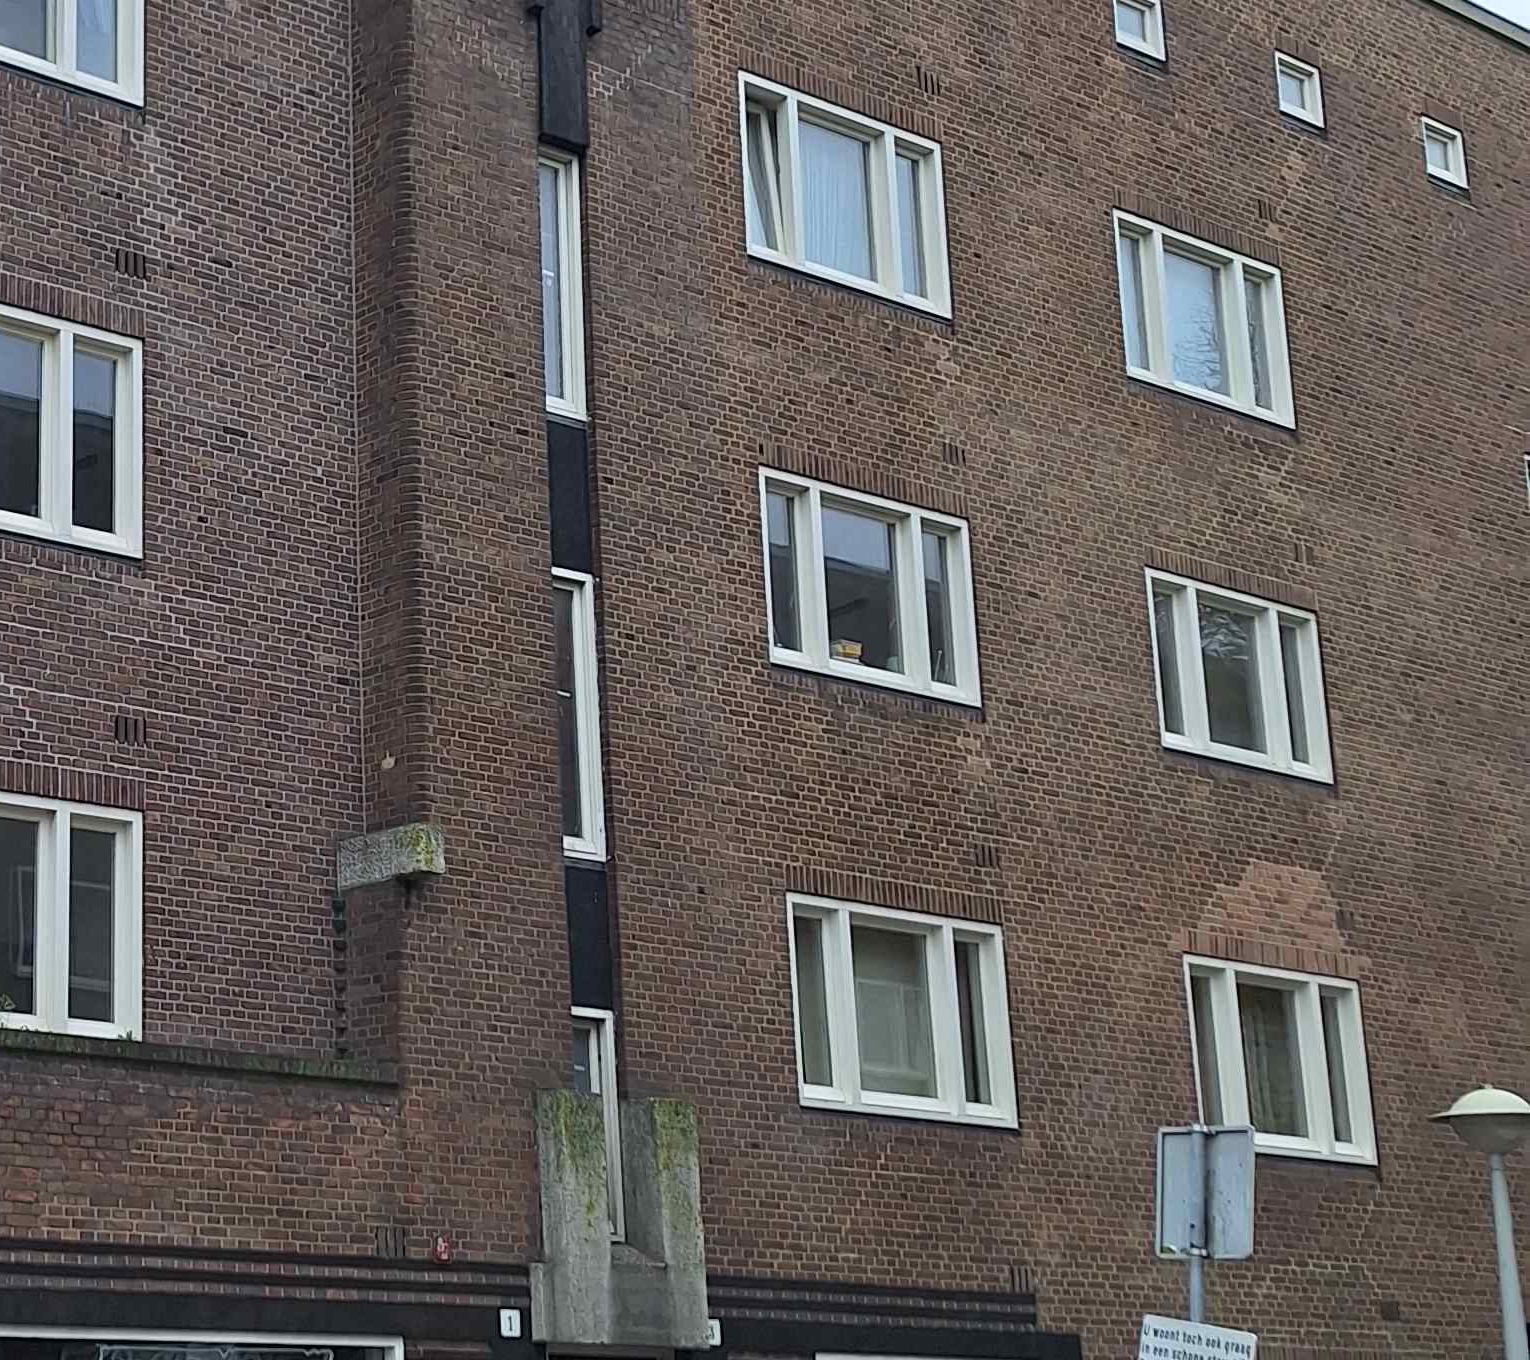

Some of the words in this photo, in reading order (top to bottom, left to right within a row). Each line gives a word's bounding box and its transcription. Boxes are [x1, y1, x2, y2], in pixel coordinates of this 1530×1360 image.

[1142, 1343, 1150, 1353] in
[1152, 1344, 1169, 1357] een
[1143, 1323, 1151, 1336] U
[1153, 1327, 1180, 1342] woont
[1182, 1331, 1203, 1346] toch
[1205, 1335, 1222, 1349] ook
[1224, 1341, 1252, 1359] graag
